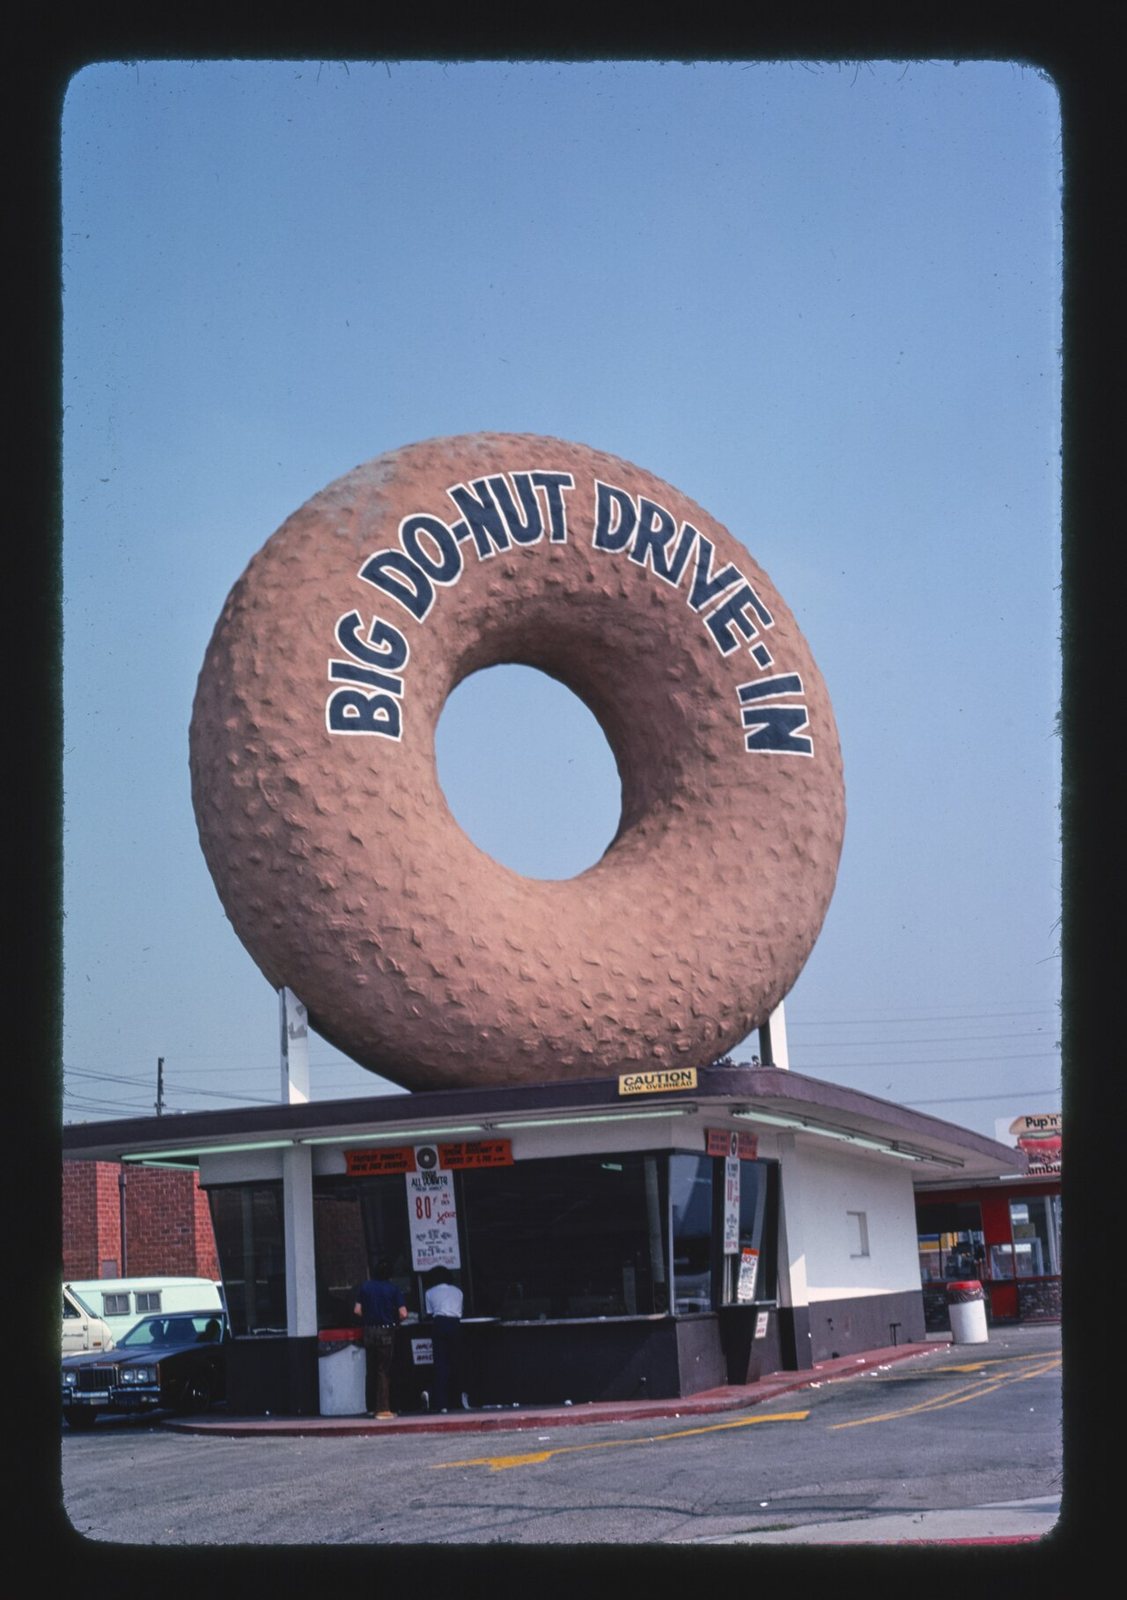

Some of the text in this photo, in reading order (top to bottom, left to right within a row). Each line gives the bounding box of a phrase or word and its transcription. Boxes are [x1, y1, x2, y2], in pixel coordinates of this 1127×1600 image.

[357, 469, 575, 623] DO-NUT
[325, 609, 410, 742] BIG
[624, 1071, 691, 1086] CAUTION
[646, 1081, 692, 1090] OVERHEAD
